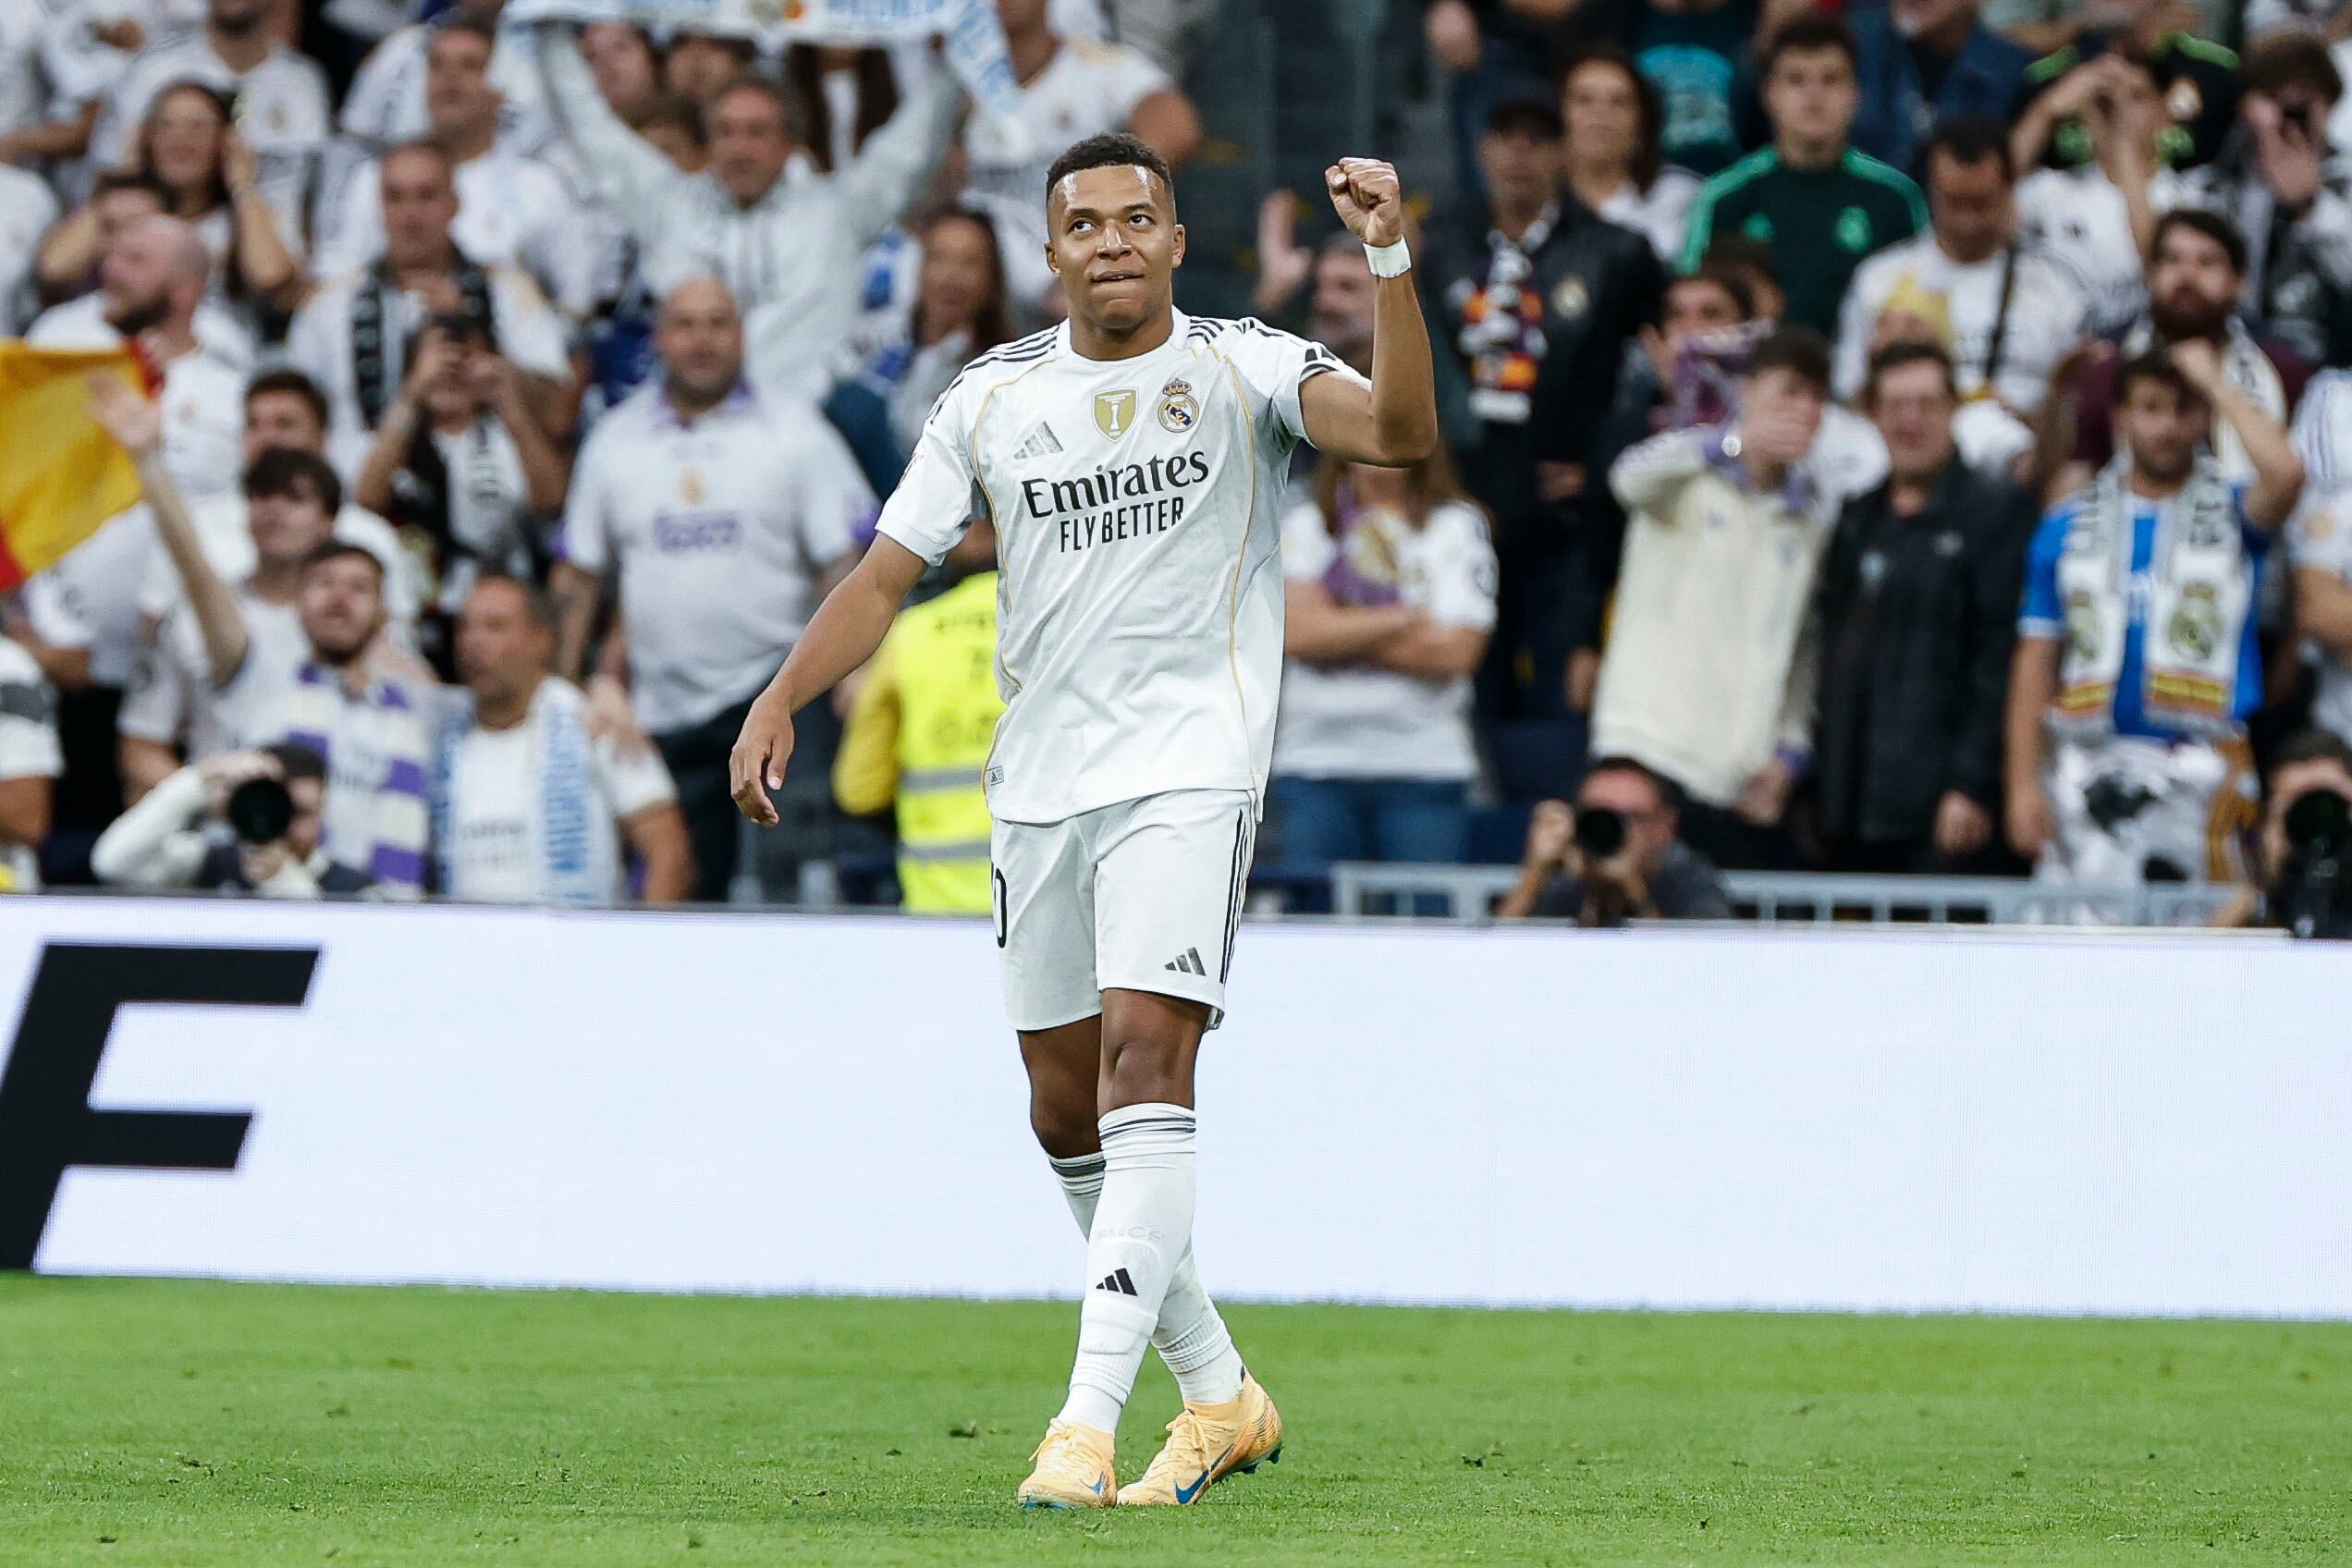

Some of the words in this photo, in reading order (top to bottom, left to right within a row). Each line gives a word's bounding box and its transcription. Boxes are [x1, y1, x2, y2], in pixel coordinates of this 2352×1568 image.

[1021, 450, 1209, 519] Emirates
[1060, 516, 1096, 553] FLY
[1101, 496, 1184, 544] BETTER
[0, 944, 320, 1268] F
